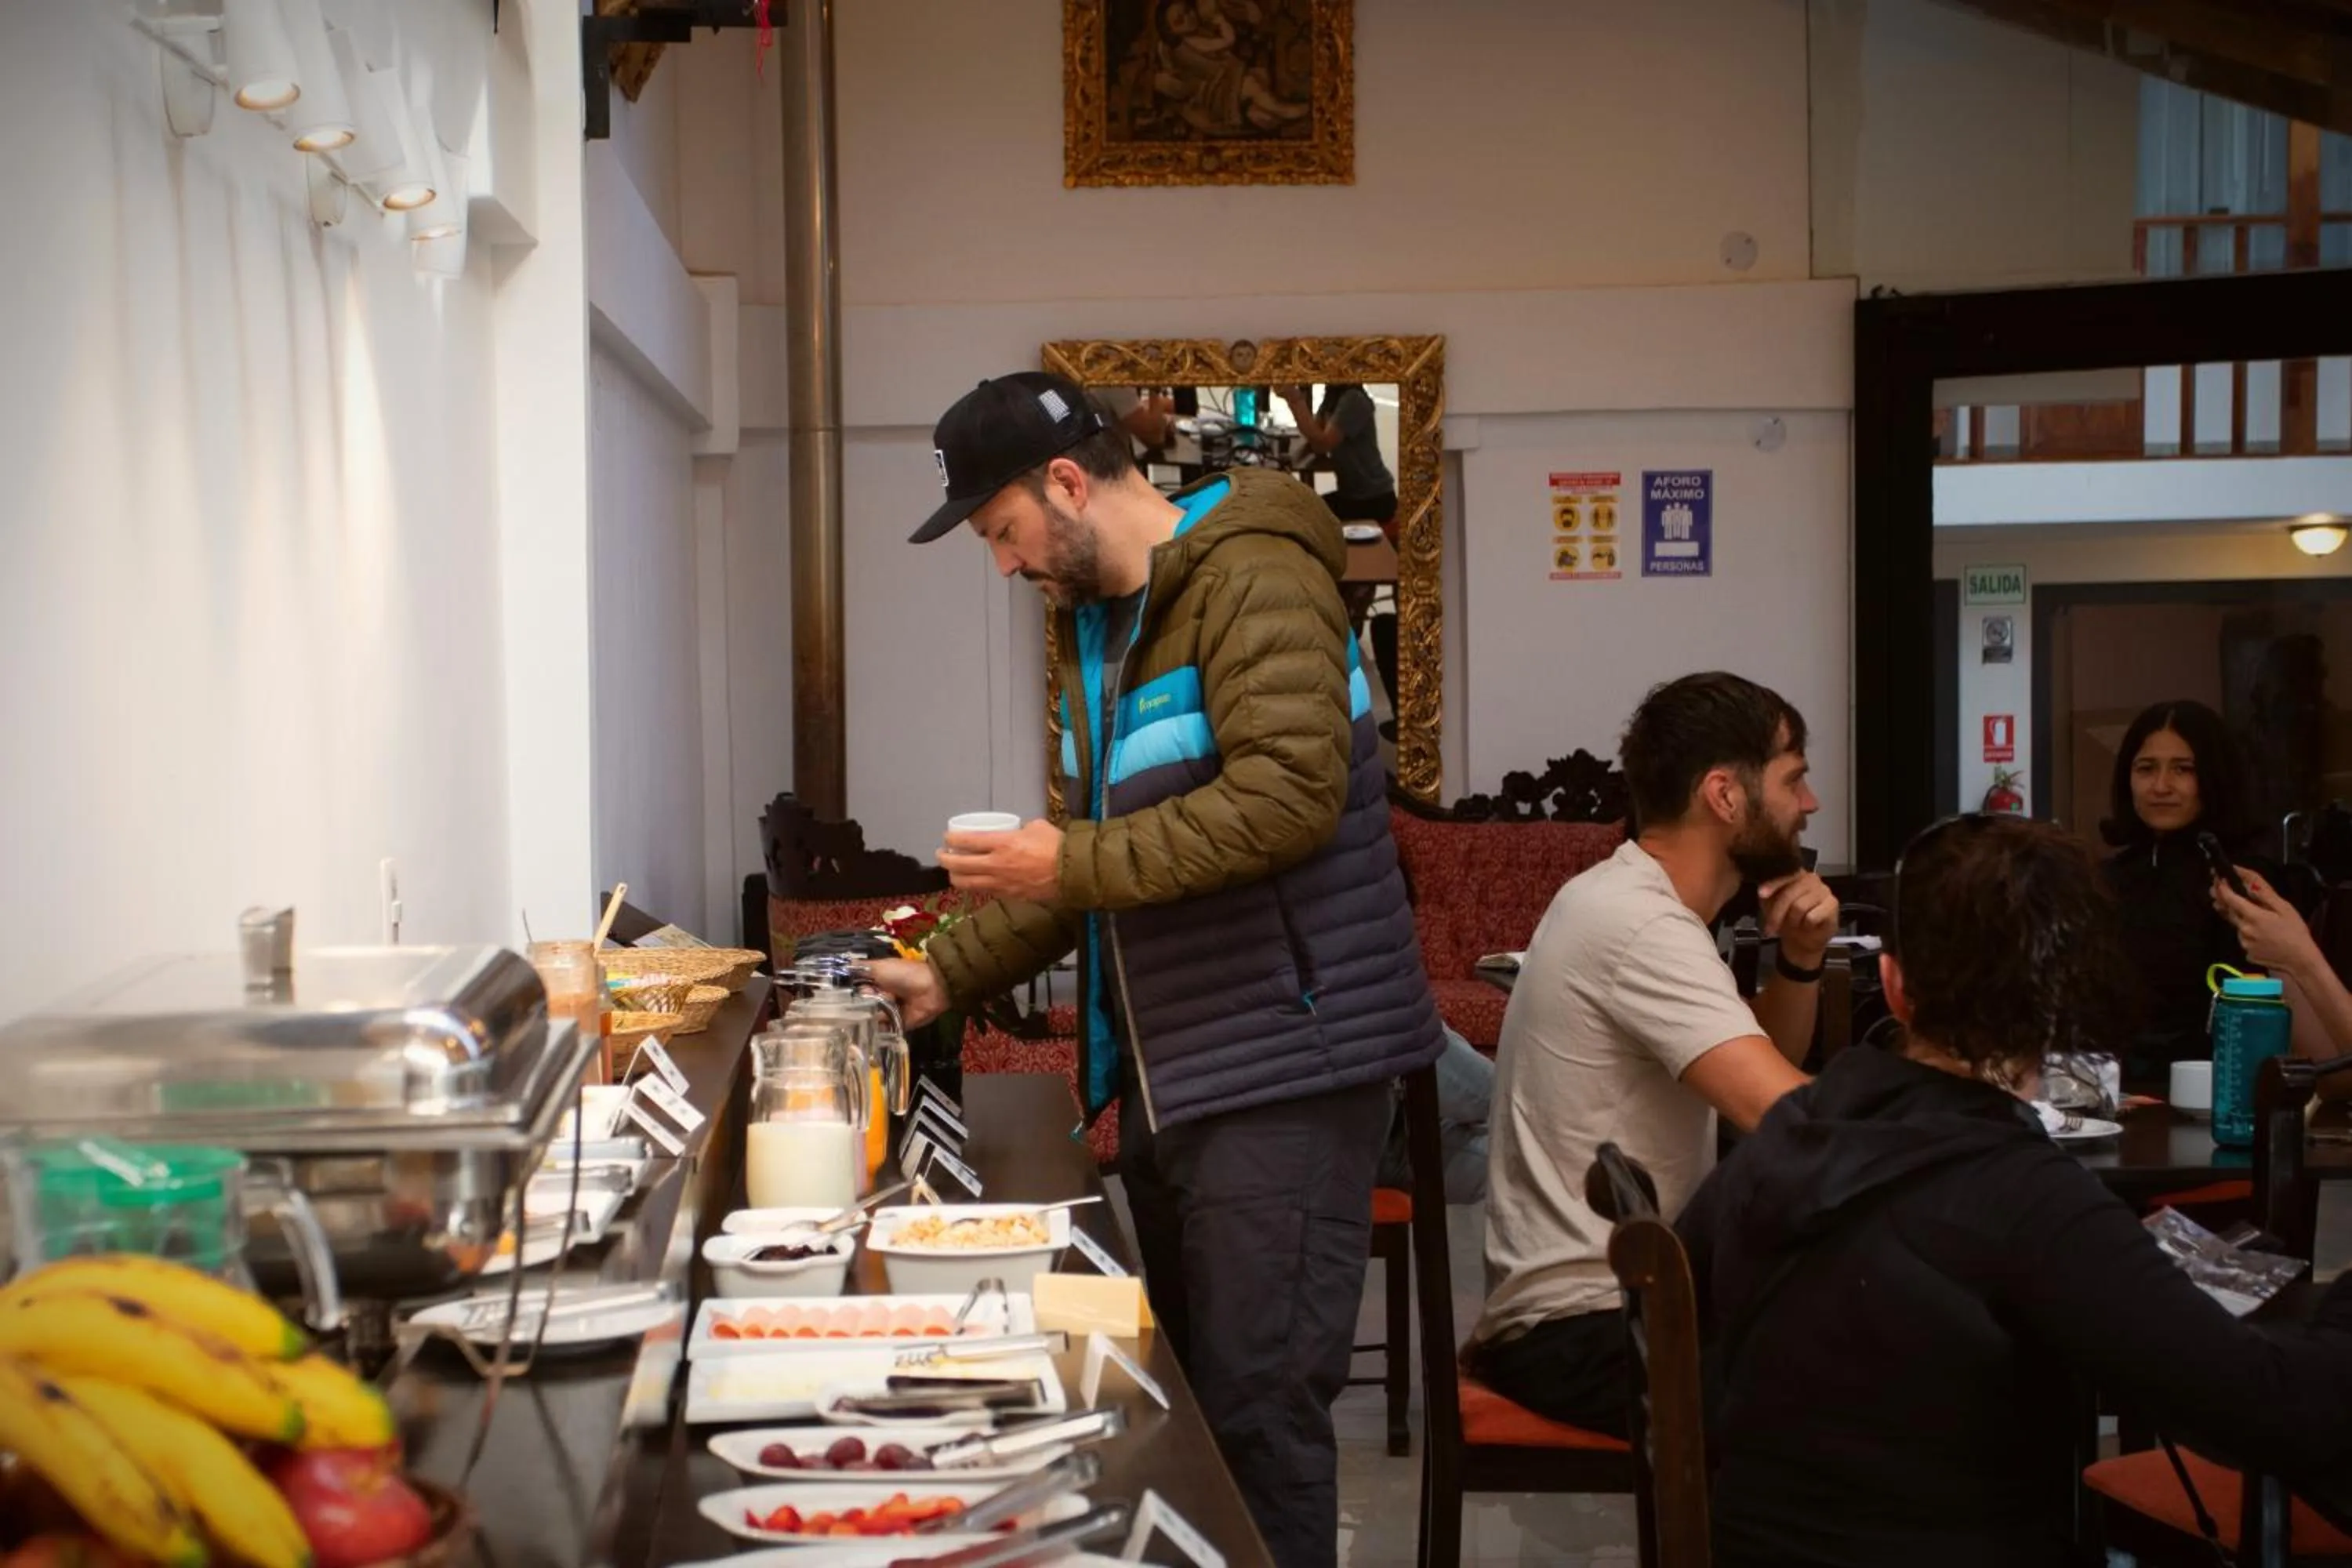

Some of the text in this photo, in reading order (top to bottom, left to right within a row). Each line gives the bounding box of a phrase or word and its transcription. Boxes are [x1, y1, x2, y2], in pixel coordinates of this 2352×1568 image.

[1653, 476, 1702, 487] AFORO
[1650, 486, 1705, 499] MÁXIMO
[1650, 561, 1704, 572] PERSONAS
[1969, 574, 2021, 595] SALIDA
